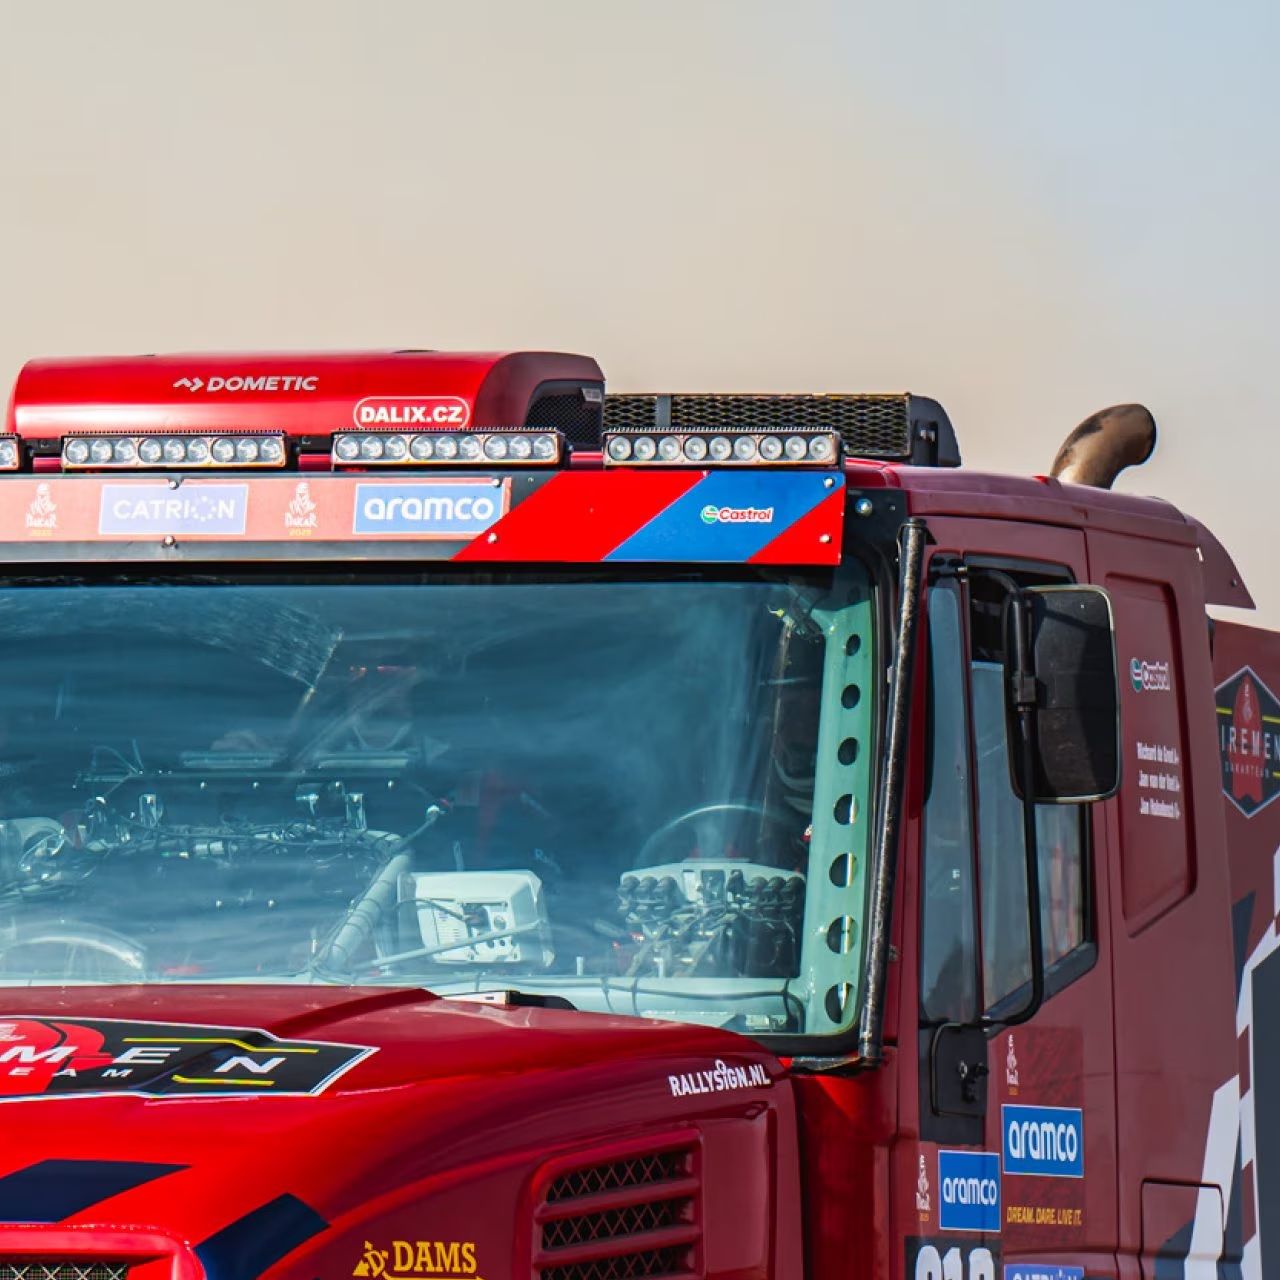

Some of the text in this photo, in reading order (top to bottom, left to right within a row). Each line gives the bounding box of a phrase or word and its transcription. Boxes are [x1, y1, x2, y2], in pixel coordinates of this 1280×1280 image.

[207, 376, 319, 391] DOMETIC
[361, 406, 463, 423] DALIX.CZ
[113, 495, 235, 522] CATRION
[364, 498, 494, 520] aramco
[719, 507, 774, 523] Castrol
[285, 512, 318, 528] DAKAR
[667, 1059, 772, 1097] RALLYSIGN.NL
[1008, 1119, 1078, 1162] aramco
[942, 1177, 997, 1206] aramco
[1006, 1206, 1036, 1224] DREAM.
[1036, 1207, 1057, 1225] DARE.
[1058, 1208, 1073, 1225] LIVE
[392, 1240, 477, 1274] DAMS
